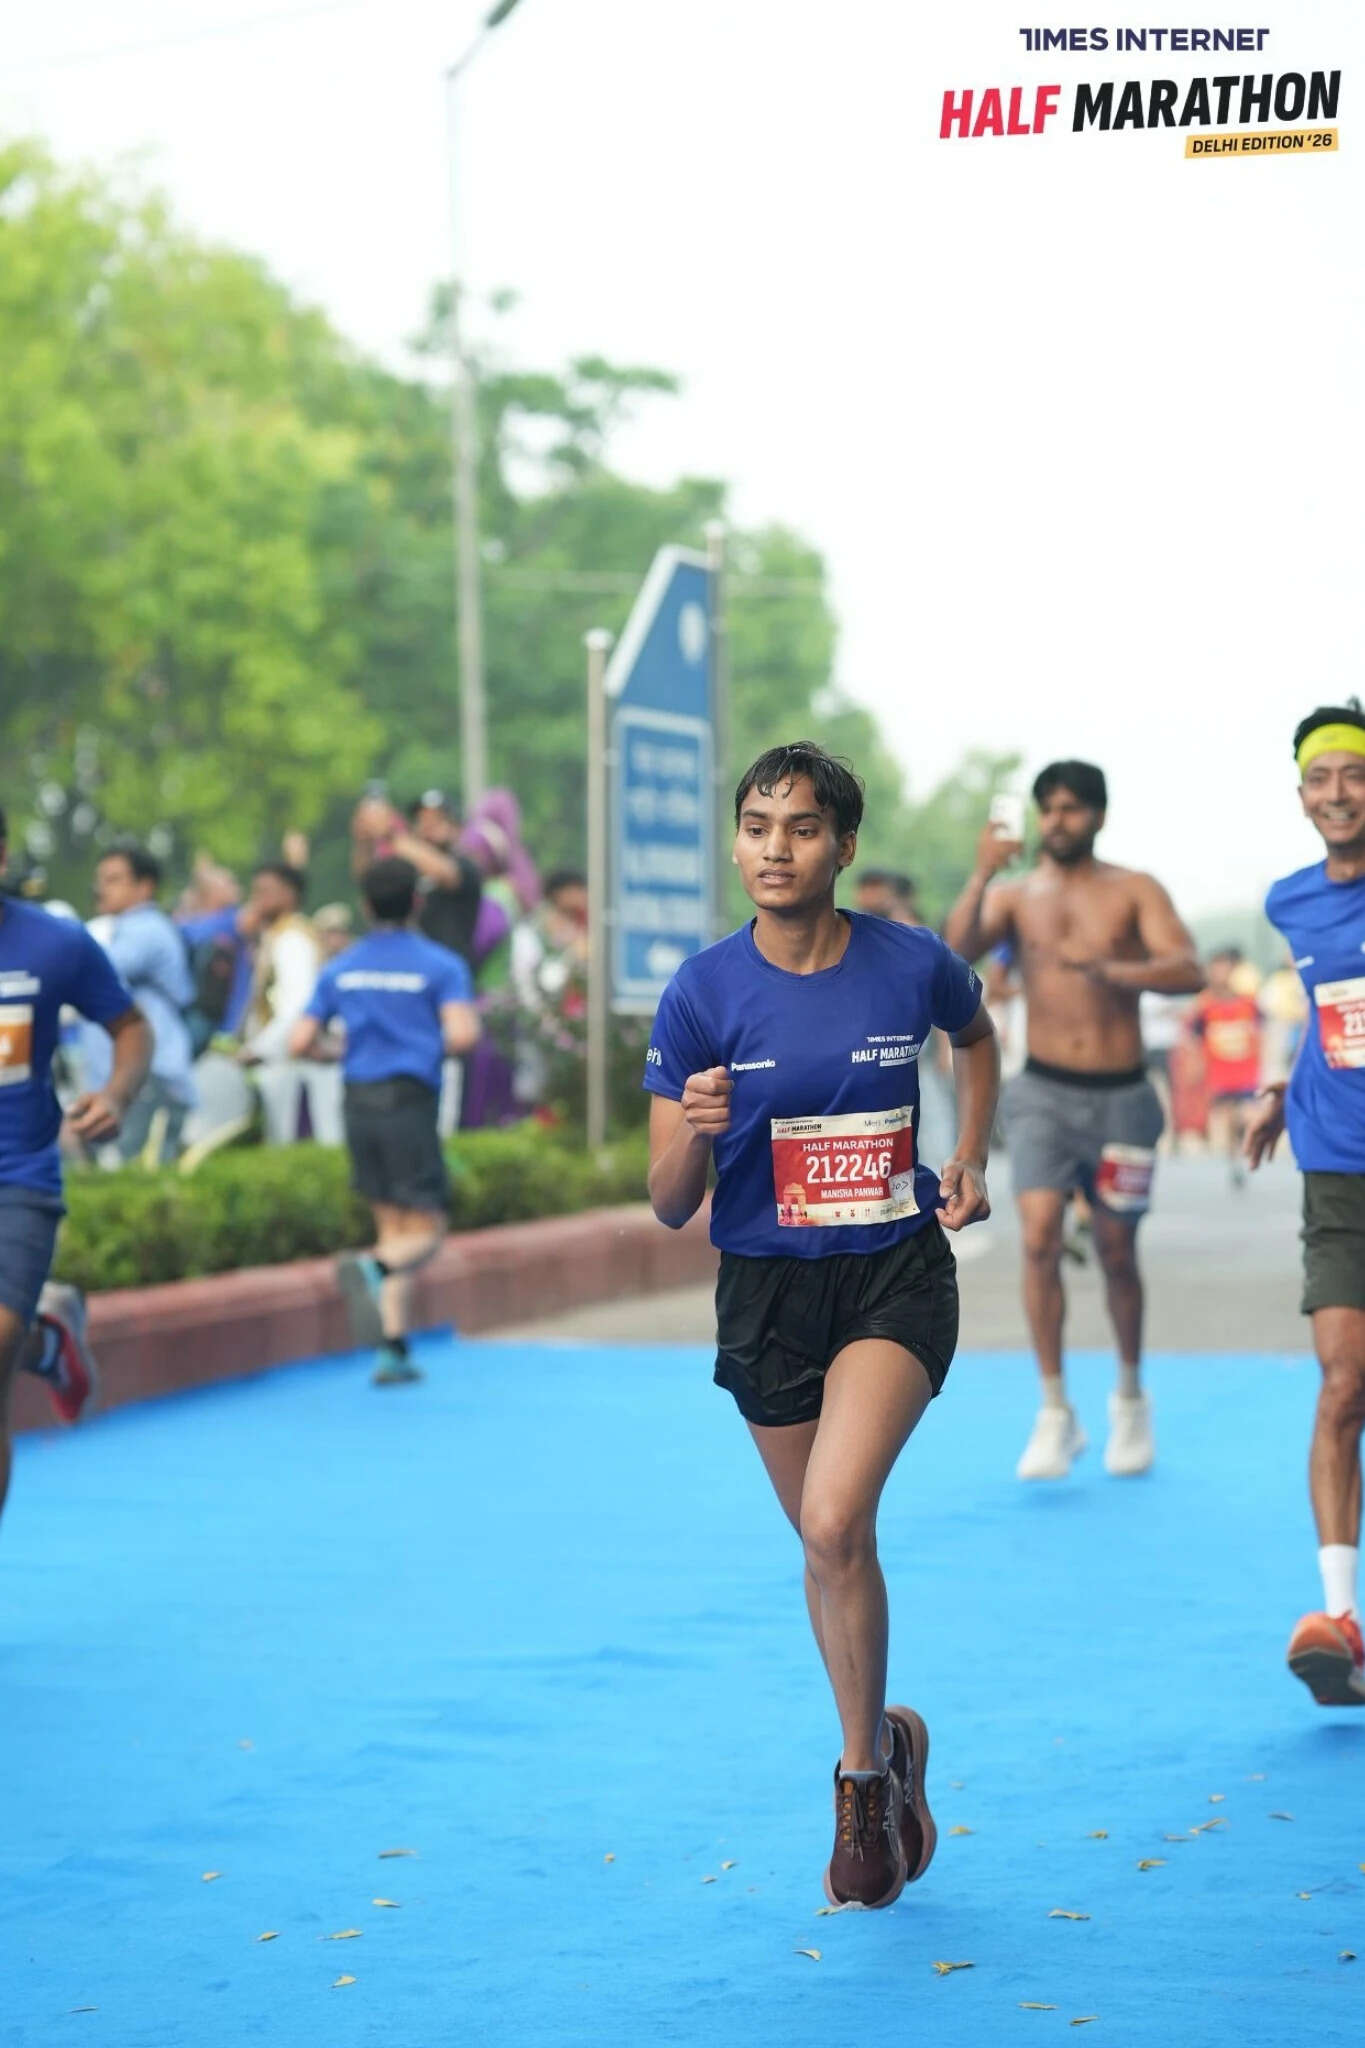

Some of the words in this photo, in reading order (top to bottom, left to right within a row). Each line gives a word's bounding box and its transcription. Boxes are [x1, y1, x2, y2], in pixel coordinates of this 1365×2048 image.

[851, 1049, 878, 1063] HALF
[731, 1059, 776, 1072] Panasonic
[803, 1143, 831, 1152] HALF
[832, 1138, 894, 1151] MARATHON
[806, 1152, 892, 1184] 212246
[820, 1188, 853, 1199] MANISHA
[854, 1186, 884, 1198] PANWAR
